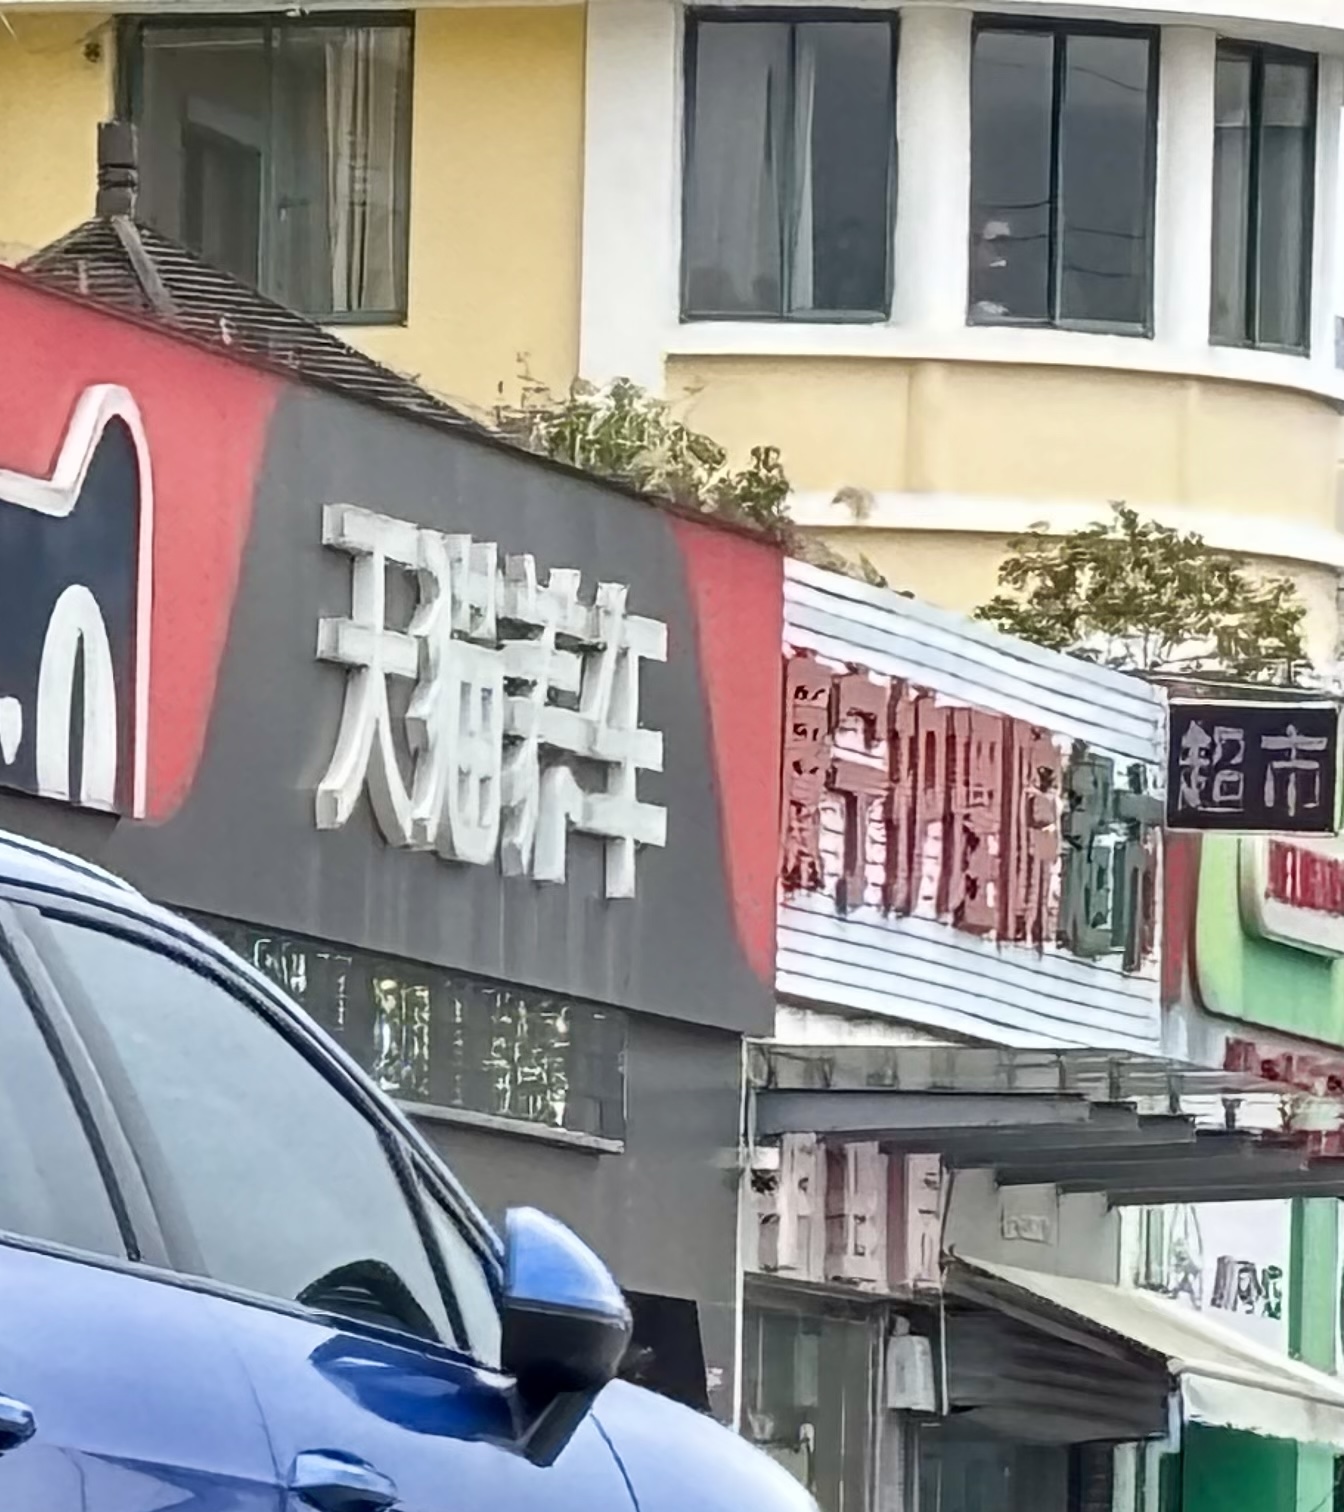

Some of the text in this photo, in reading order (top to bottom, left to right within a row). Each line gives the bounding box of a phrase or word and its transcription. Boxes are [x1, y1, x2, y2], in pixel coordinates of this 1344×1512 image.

[315, 503, 668, 899] 天猫养车
[1178, 719, 1329, 818] 超市
